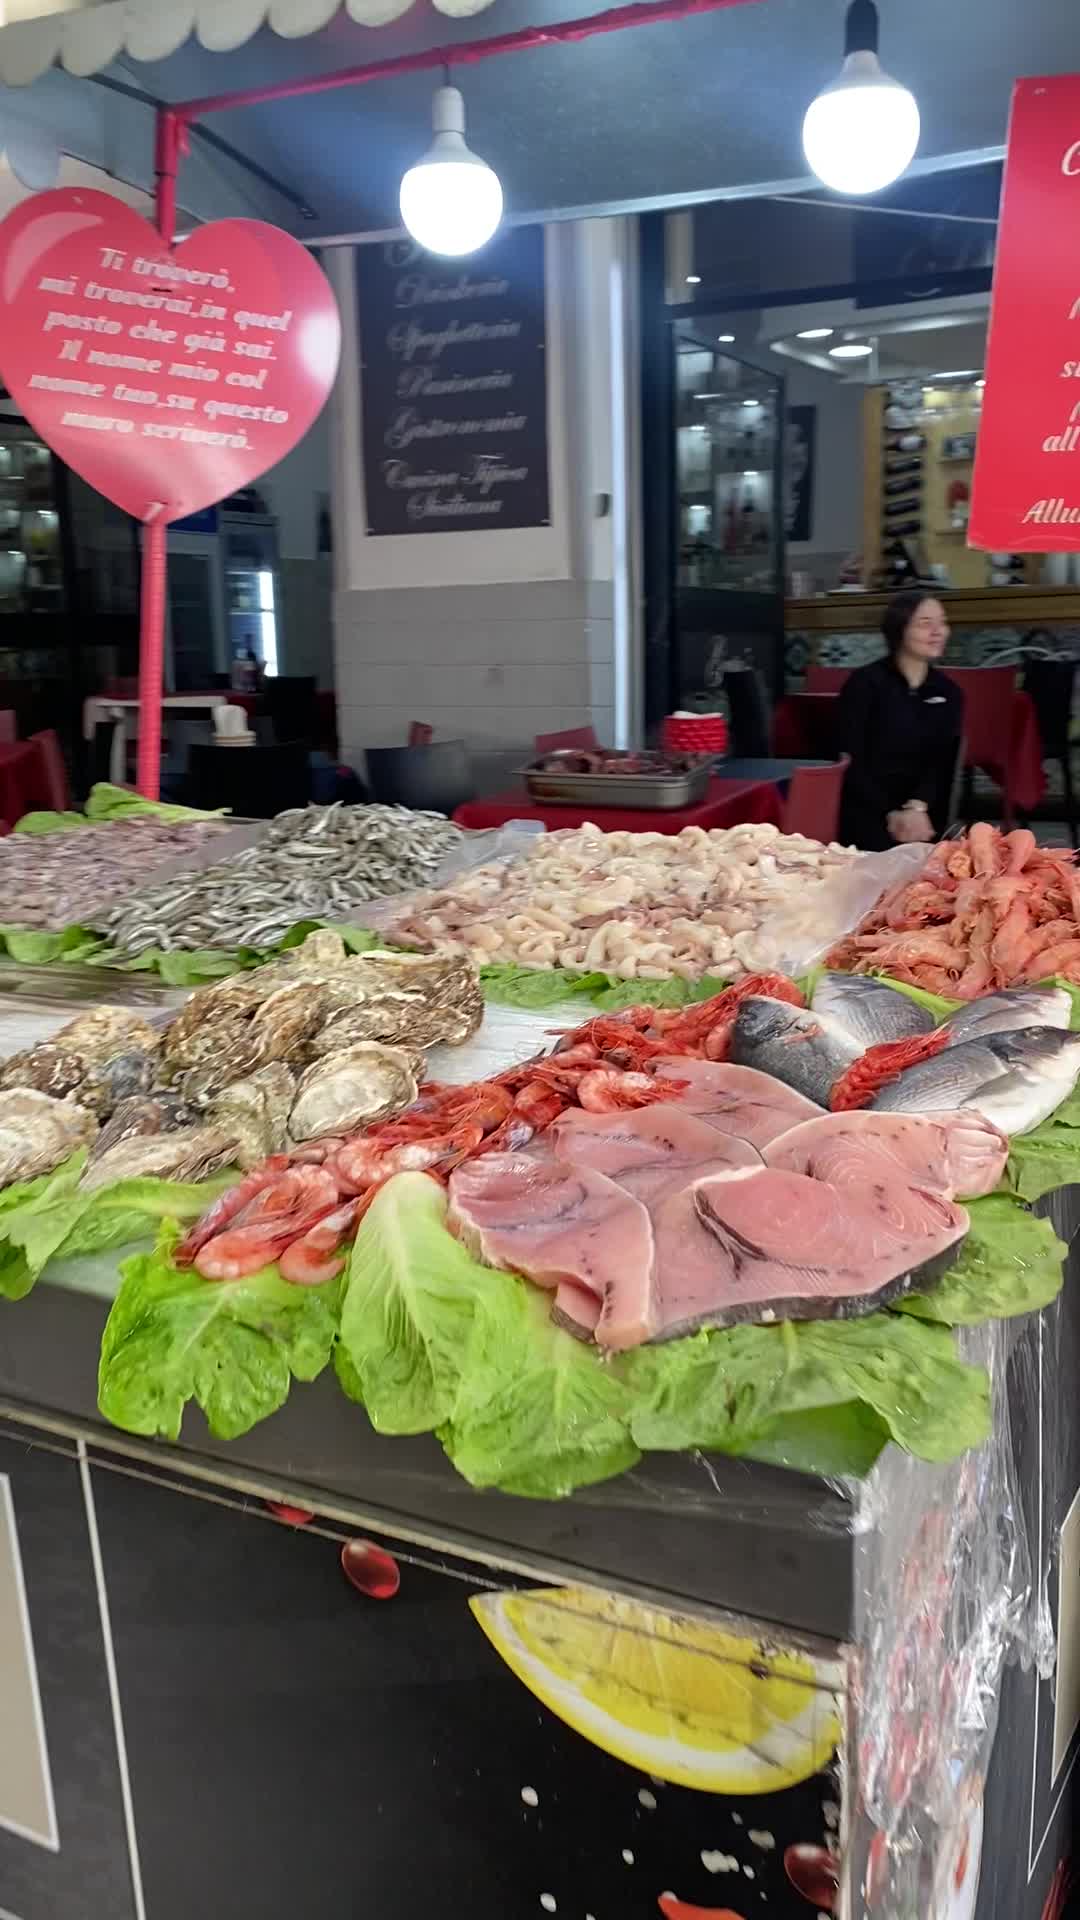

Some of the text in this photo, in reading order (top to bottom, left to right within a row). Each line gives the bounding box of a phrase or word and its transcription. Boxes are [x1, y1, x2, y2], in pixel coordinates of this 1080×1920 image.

[100, 246, 127, 271] Ti
[38, 275, 78, 296] mi
[233, 310, 293, 331] quel
[42, 311, 123, 335] posto
[128, 319, 177, 343] che
[86, 350, 162, 373] nome
[225, 368, 268, 390] col
[27, 374, 106, 398] nome
[203, 400, 289, 424] questo
